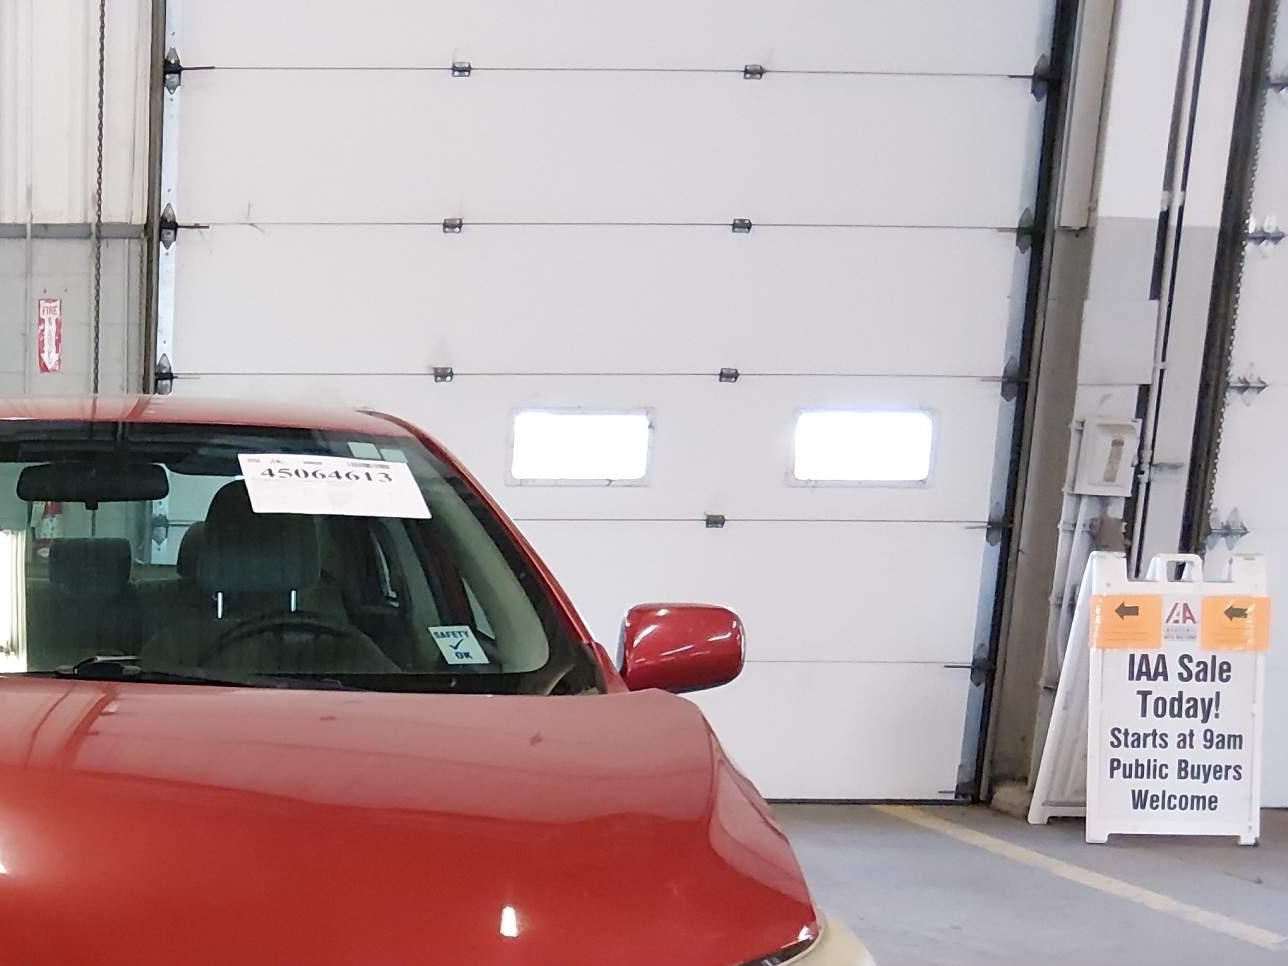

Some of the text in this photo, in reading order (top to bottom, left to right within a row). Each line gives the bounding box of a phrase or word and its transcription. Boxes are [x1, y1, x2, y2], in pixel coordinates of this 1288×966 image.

[261, 468, 392, 482] 45064613
[433, 631, 469, 639] SAFETY
[455, 651, 472, 659] OK
[1128, 654, 1231, 683] IAA Sale
[1136, 690, 1220, 724] Today!
[1109, 727, 1243, 750] Starts at 9am
[1109, 758, 1242, 784] Public Buyers
[1131, 789, 1218, 811] Welcome
